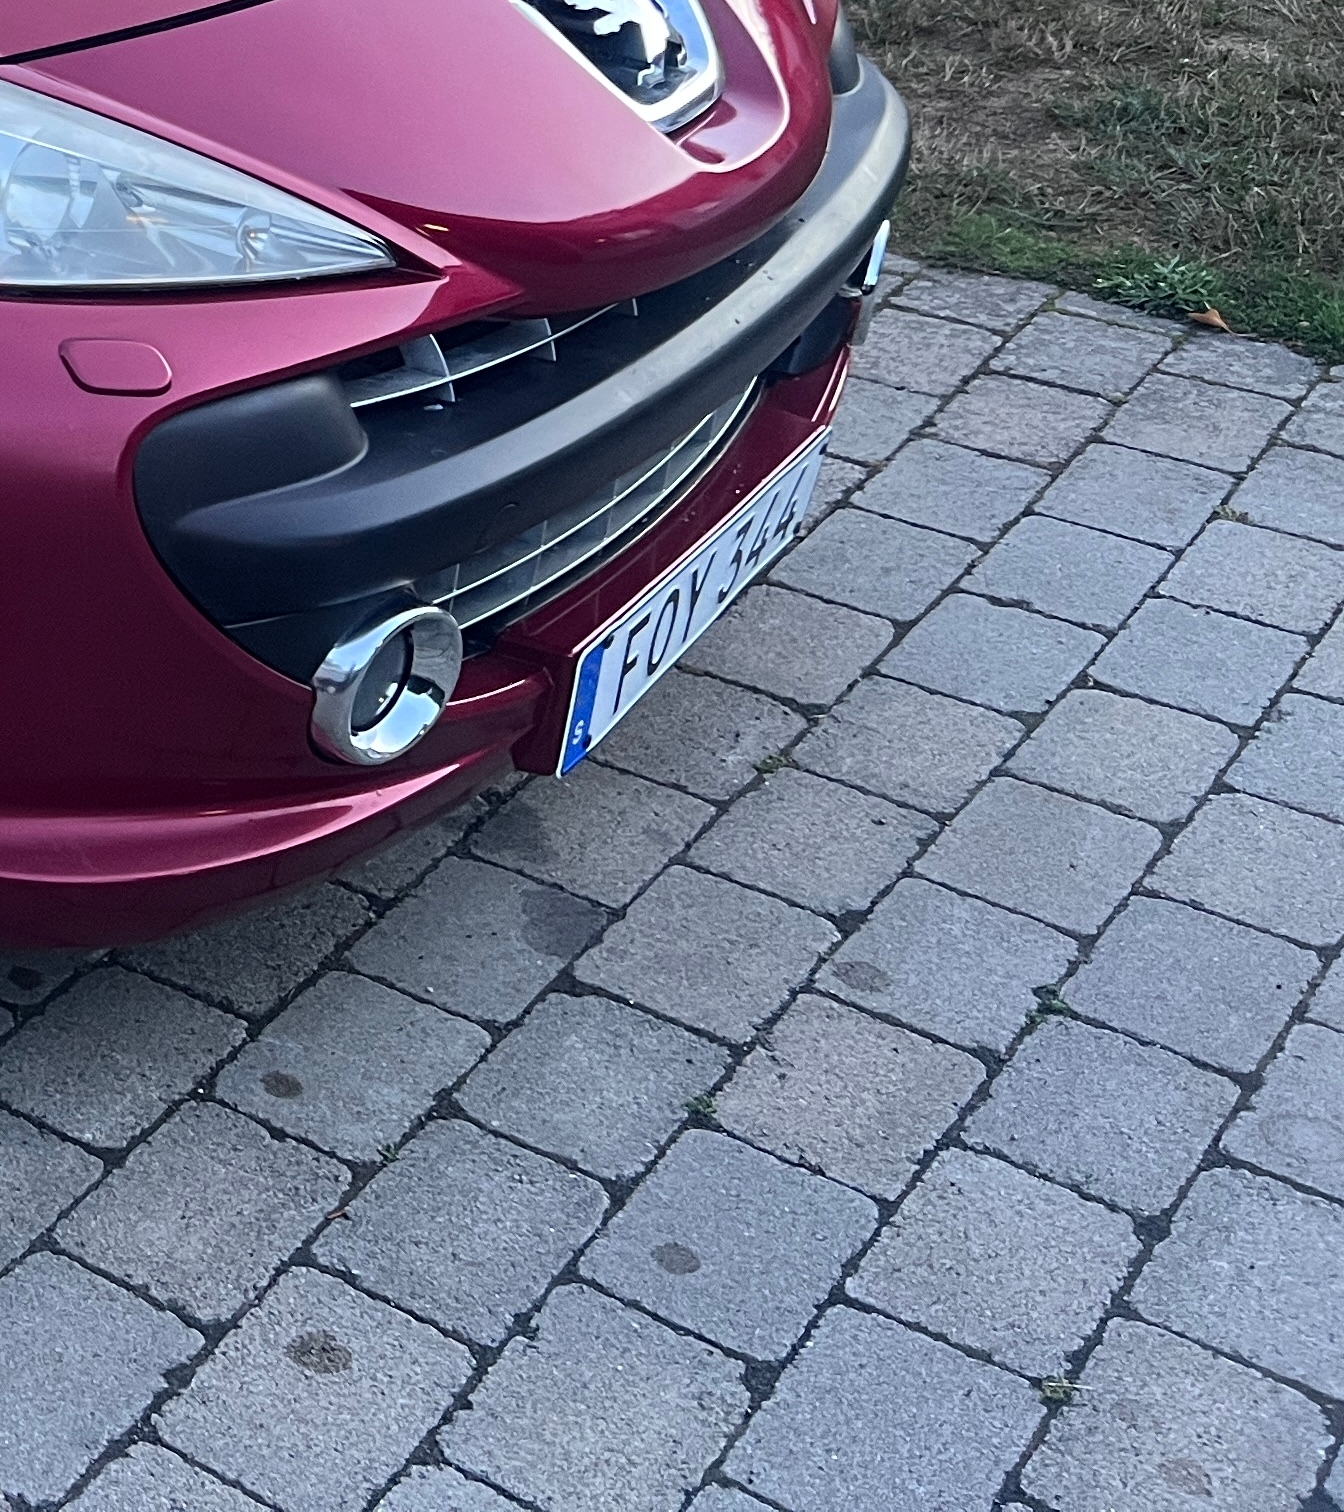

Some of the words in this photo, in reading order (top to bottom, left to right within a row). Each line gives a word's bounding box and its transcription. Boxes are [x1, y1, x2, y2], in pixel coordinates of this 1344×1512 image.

[613, 549, 717, 715] FOY
[718, 462, 810, 605] 344
[571, 719, 585, 745] S
